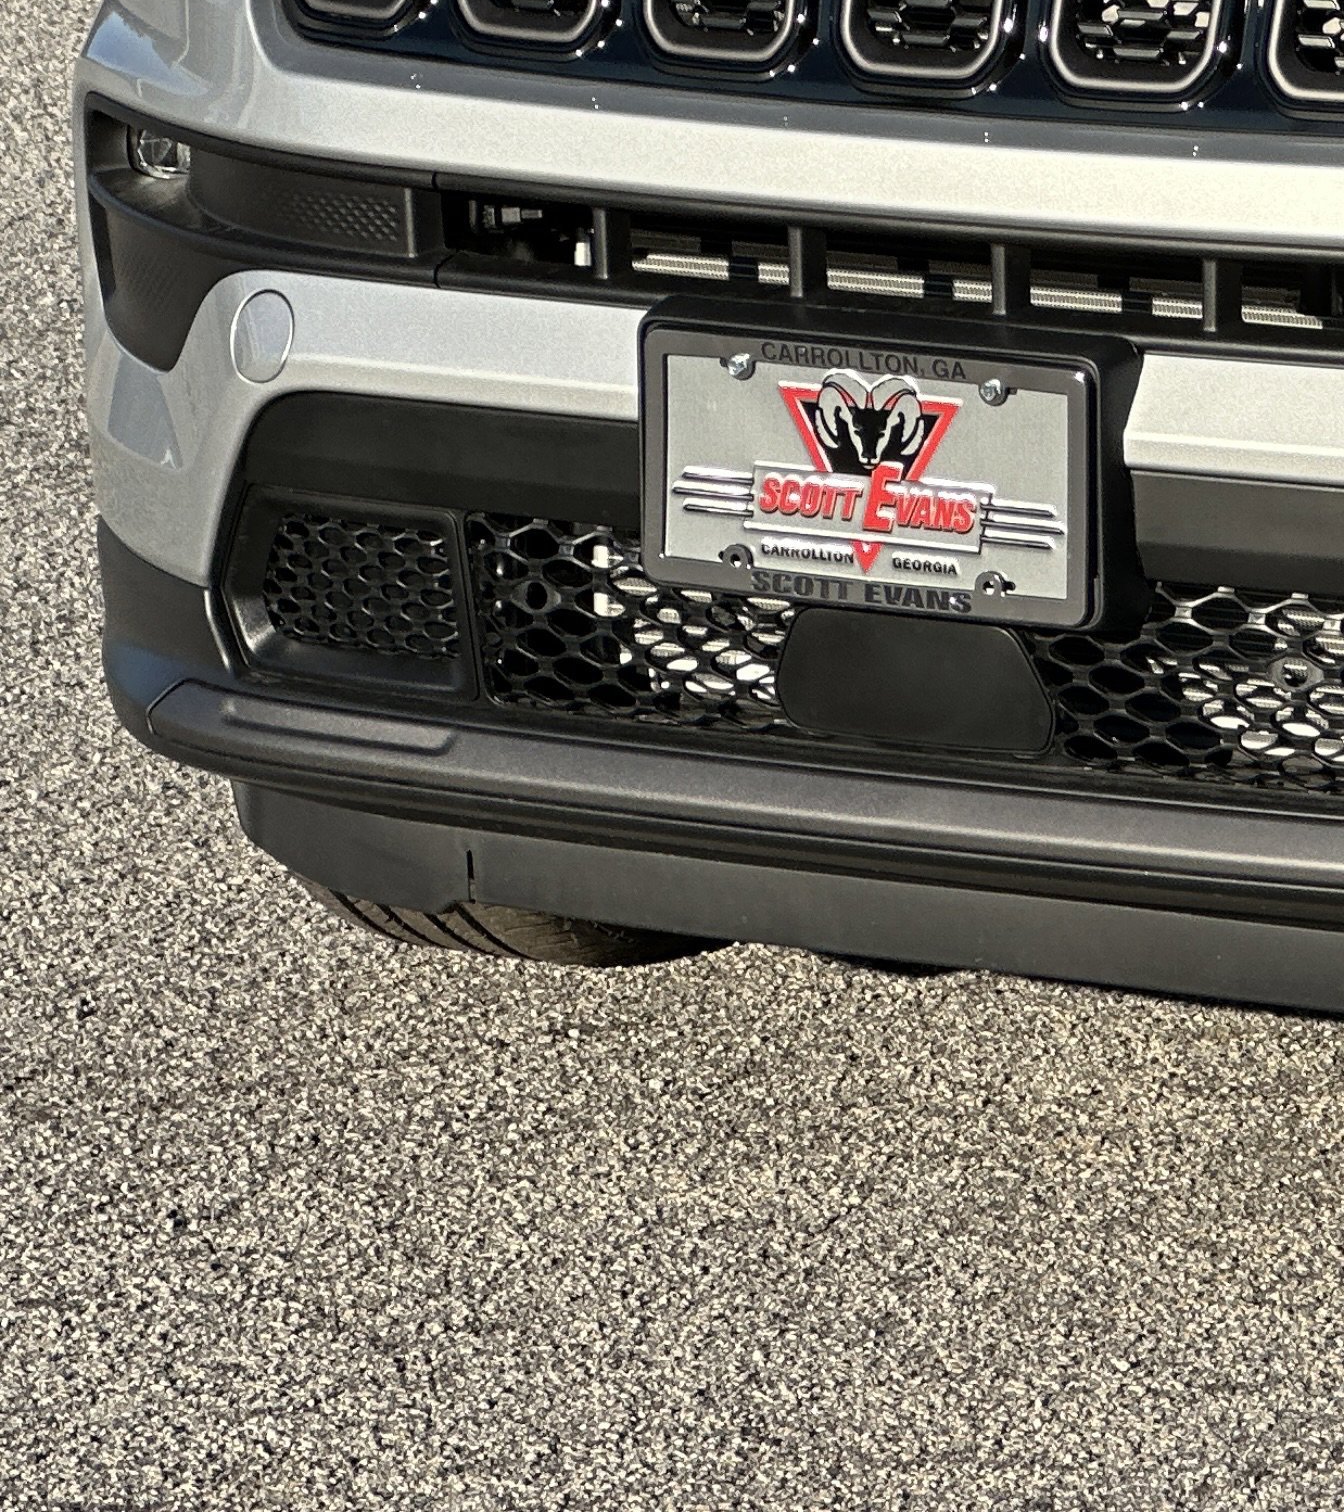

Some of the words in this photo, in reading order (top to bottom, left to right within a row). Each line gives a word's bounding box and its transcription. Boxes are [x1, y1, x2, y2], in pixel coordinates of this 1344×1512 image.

[761, 341, 926, 377] CARROLLTON,
[931, 358, 967, 380] GA
[758, 473, 864, 522] SCOTT
[862, 462, 977, 534] EVANS
[761, 542, 854, 565] CARROLLTON
[892, 556, 958, 576] GEORGIA
[751, 570, 852, 602] SCOTT
[863, 582, 973, 614] EVANS
